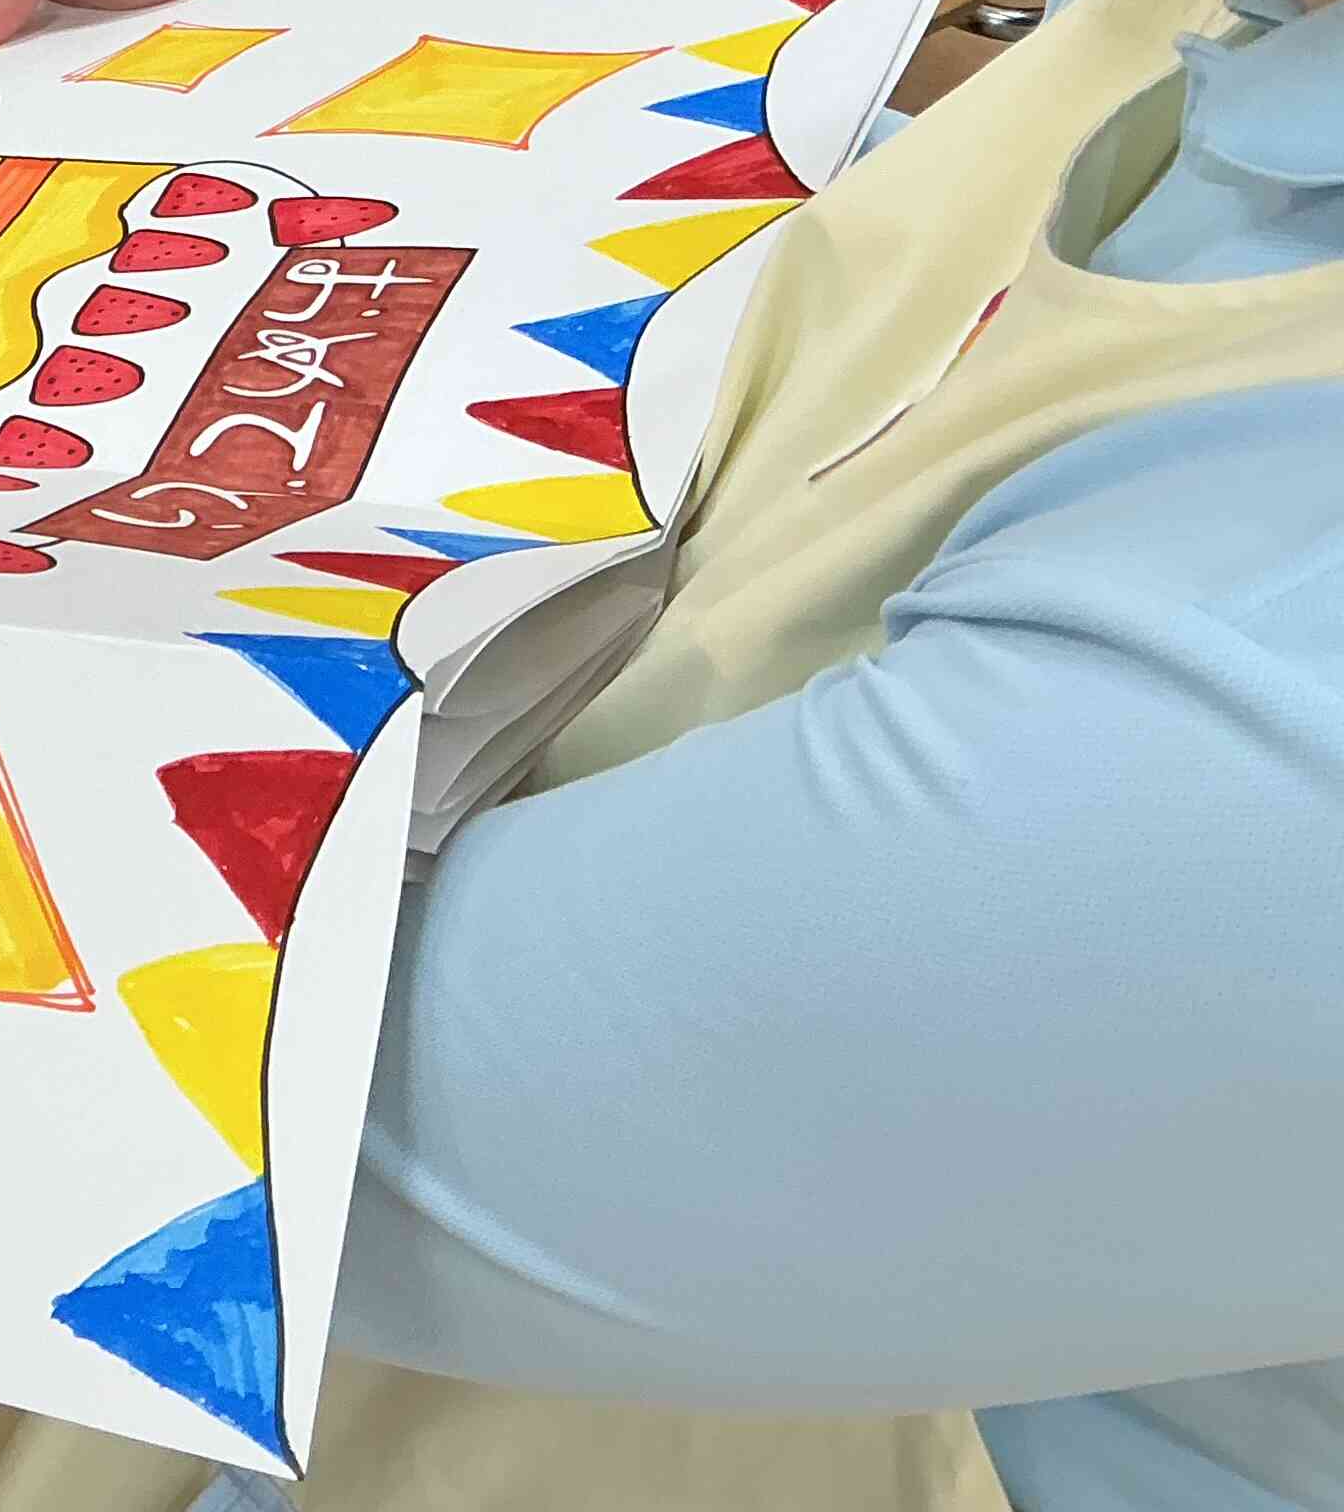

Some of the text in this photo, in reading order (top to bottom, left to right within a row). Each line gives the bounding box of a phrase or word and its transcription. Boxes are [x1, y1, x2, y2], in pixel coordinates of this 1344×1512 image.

[91, 258, 433, 530] おめでとう
